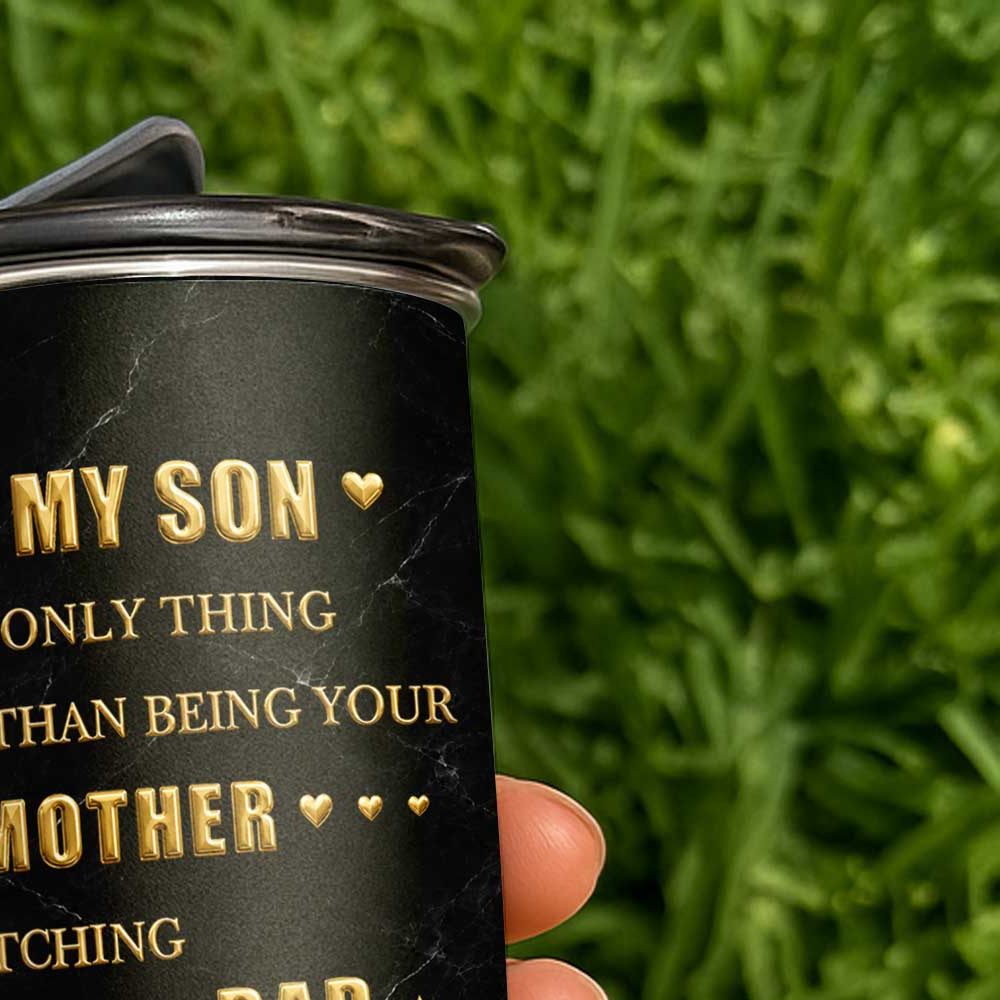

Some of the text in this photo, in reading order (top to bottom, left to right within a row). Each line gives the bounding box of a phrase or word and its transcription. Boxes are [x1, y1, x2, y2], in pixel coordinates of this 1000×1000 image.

[10, 464, 128, 556] MY
[155, 458, 319, 544] SON
[0, 597, 145, 649] ONLY
[158, 590, 338, 638] THING
[144, 688, 301, 737] BEING
[312, 684, 457, 726] YOUR
